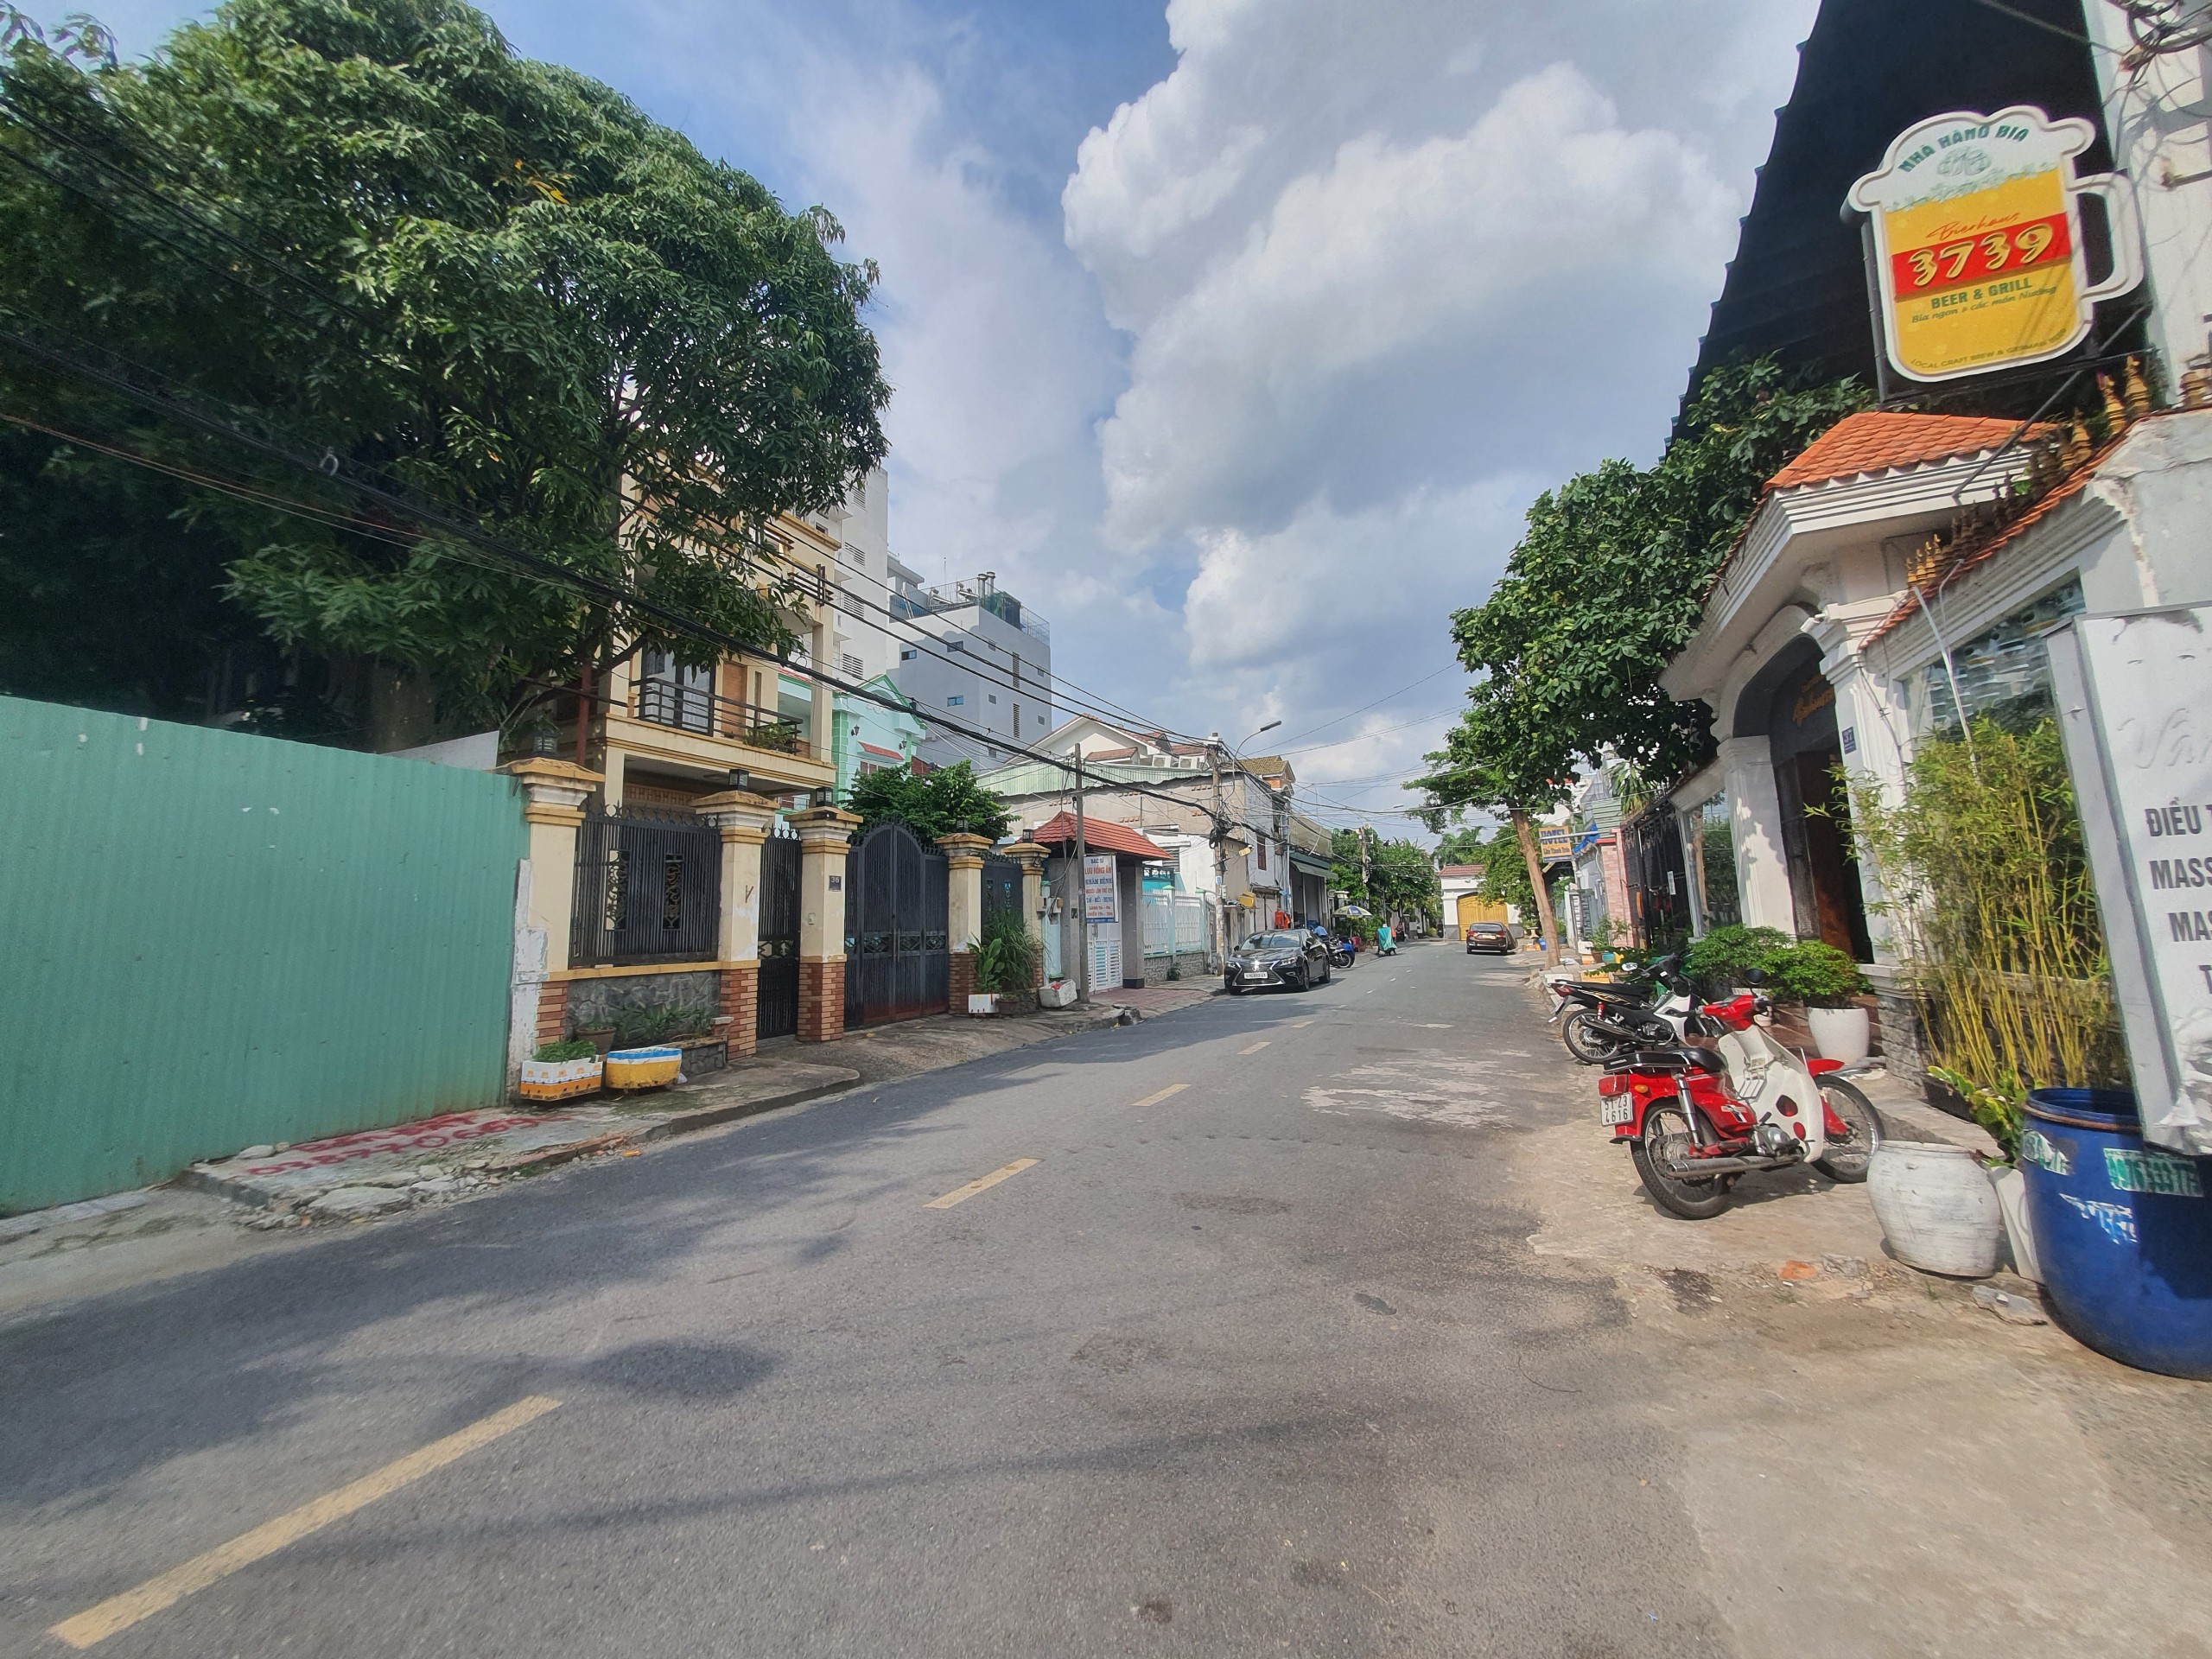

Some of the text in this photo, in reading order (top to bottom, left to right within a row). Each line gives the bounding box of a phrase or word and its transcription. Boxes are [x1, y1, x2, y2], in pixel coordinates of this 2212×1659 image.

[1897, 124, 2029, 172] NHÀ HÀNG BIA
[1908, 223, 2054, 287] 3739
[1930, 277, 2032, 309] BEER & GRILL
[1912, 312, 1929, 323] Bia
[1932, 308, 1958, 320] ngon
[1970, 301, 1987, 310] các
[1910, 359, 1938, 369] LOCAL
[1941, 356, 1968, 366] CRAFT
[1971, 352, 1995, 361] BREW
[1844, 729, 1853, 743] 37
[2144, 796, 2202, 837] ĐIỀU
[2167, 910, 2212, 943] MA
[1605, 1109, 1628, 1123] 4616
